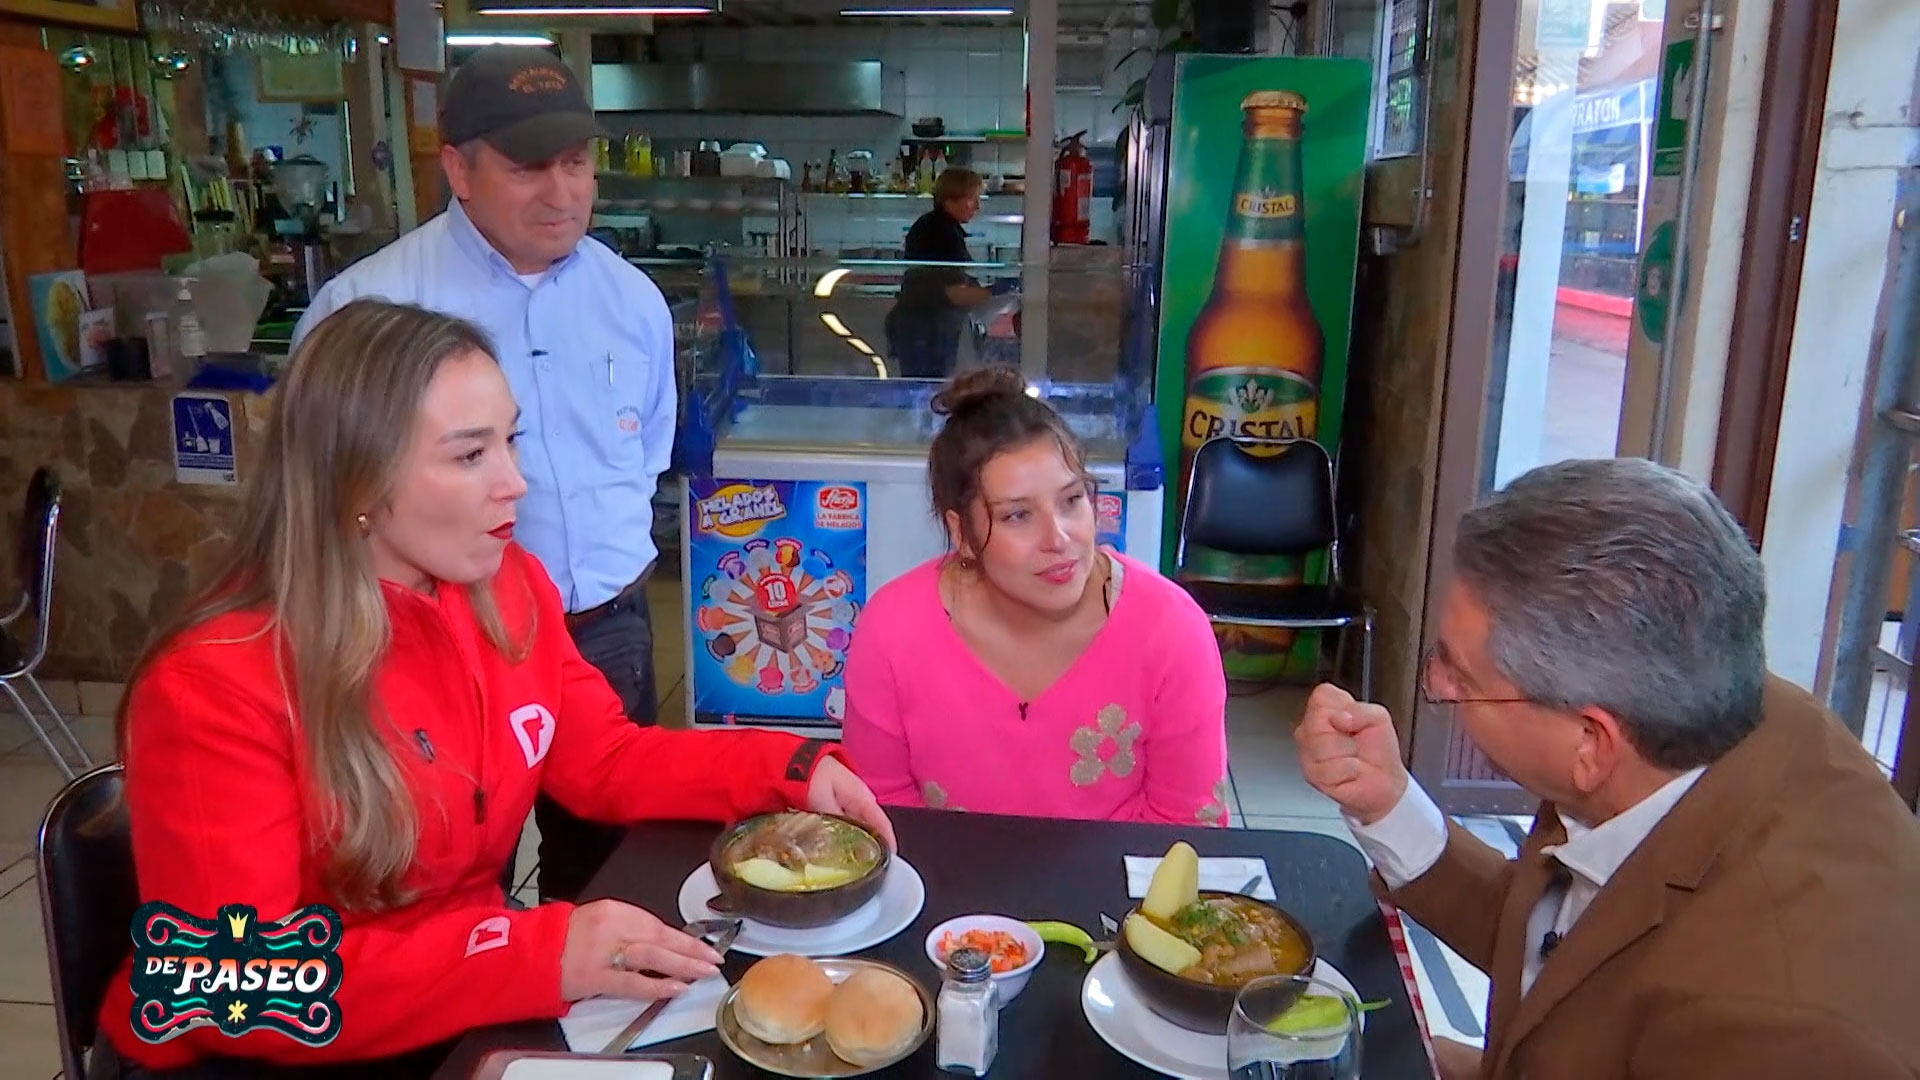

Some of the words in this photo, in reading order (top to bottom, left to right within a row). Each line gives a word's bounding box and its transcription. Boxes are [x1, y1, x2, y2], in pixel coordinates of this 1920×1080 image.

[1240, 198, 1293, 215] CRISTAL
[1189, 409, 1311, 447] CRISTAL
[702, 486, 775, 514] HELADOS
[702, 514, 714, 530] A
[764, 581, 787, 603] 10
